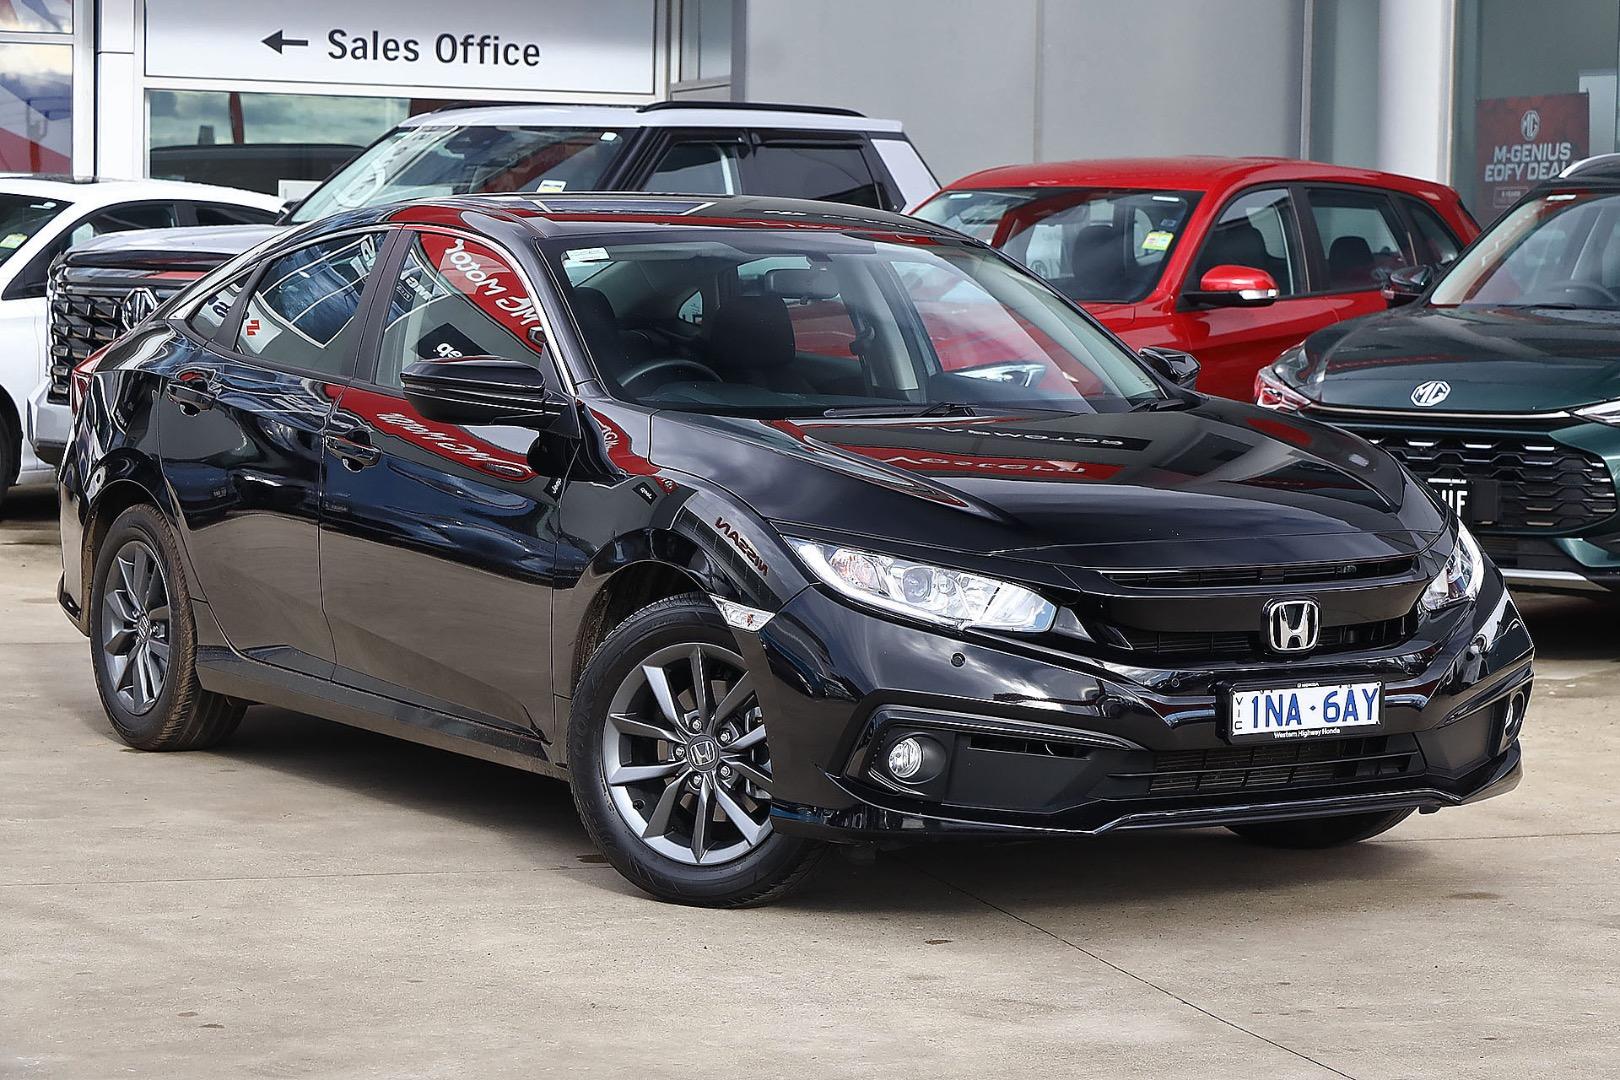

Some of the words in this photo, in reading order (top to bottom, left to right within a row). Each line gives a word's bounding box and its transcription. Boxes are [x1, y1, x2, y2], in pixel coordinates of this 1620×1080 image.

[327, 28, 419, 62] Sales
[435, 33, 540, 67] Office
[1521, 110, 1540, 141] MG
[1494, 142, 1572, 163] M-GENIUS
[1484, 163, 1526, 182] EOFY
[1526, 160, 1568, 180] DEA
[1410, 380, 1451, 407] MG
[1321, 727, 1341, 735] Honda
